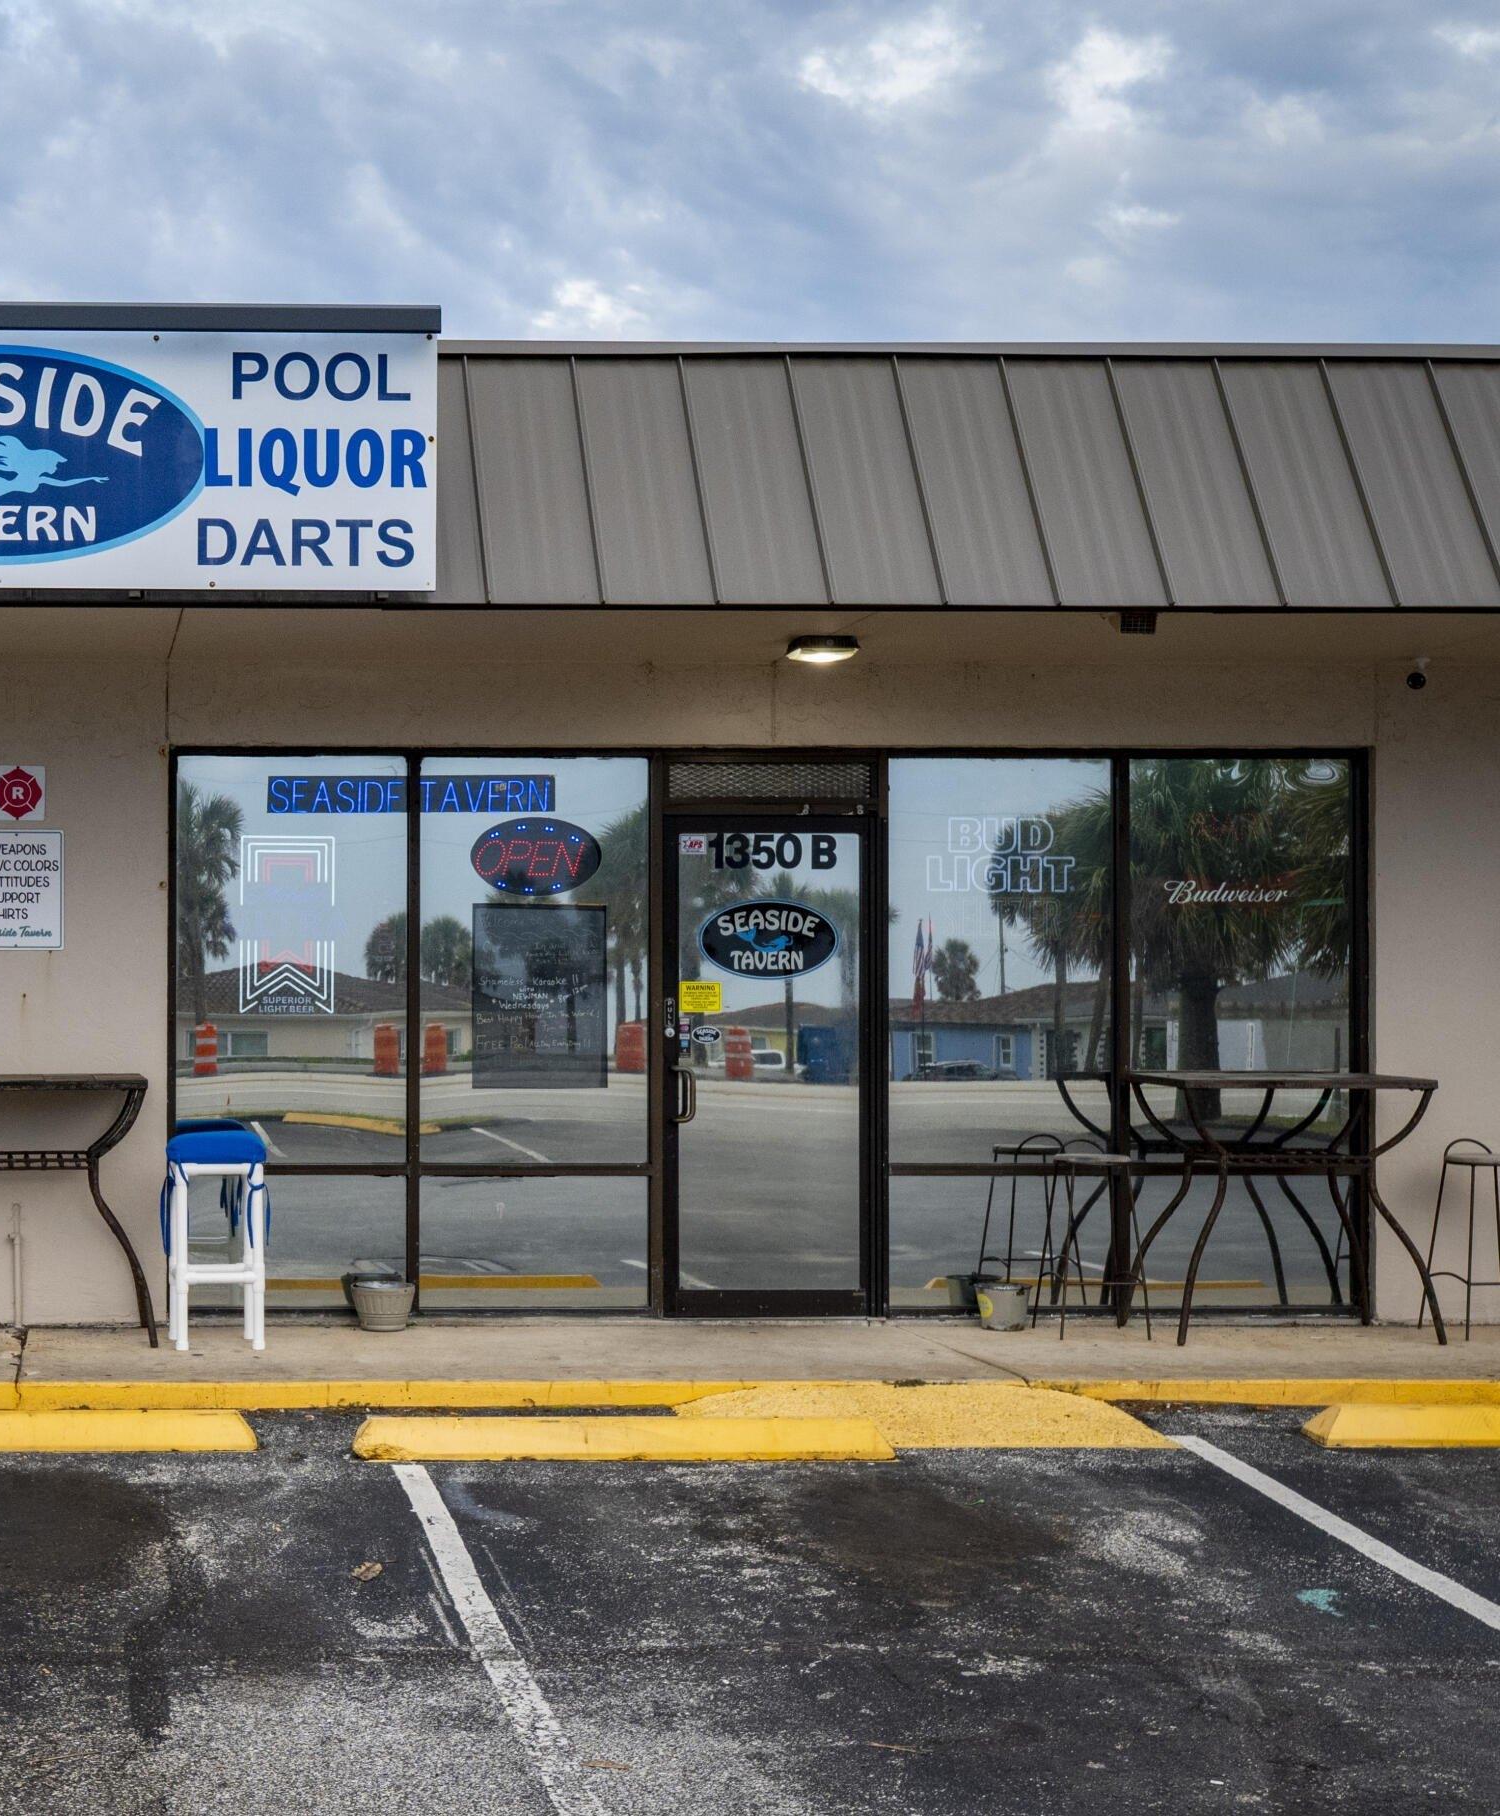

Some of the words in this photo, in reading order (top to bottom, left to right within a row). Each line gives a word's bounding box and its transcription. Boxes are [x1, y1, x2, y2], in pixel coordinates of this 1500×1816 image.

[232, 352, 412, 401] POOL
[203, 427, 428, 497] LIQUOR
[198, 518, 417, 568] DARTS
[11, 786, 25, 800] R
[419, 779, 550, 814] TAVERN
[687, 840, 704, 849] APS
[947, 817, 1054, 853] BUD
[14, 860, 59, 872] COLORS
[474, 839, 586, 878] OPEN
[708, 833, 803, 870] 1350
[811, 834, 838, 870] B
[926, 855, 1075, 893] LIGHT
[1163, 880, 1289, 905] Budweiser
[19, 926, 52, 939] Tavern
[716, 909, 821, 938] SEASIDE
[729, 950, 804, 970] TAVERN
[258, 1005, 287, 1013] LIGHT
[288, 1005, 315, 1013] BEER
[262, 996, 312, 1004] SUPERIOR
